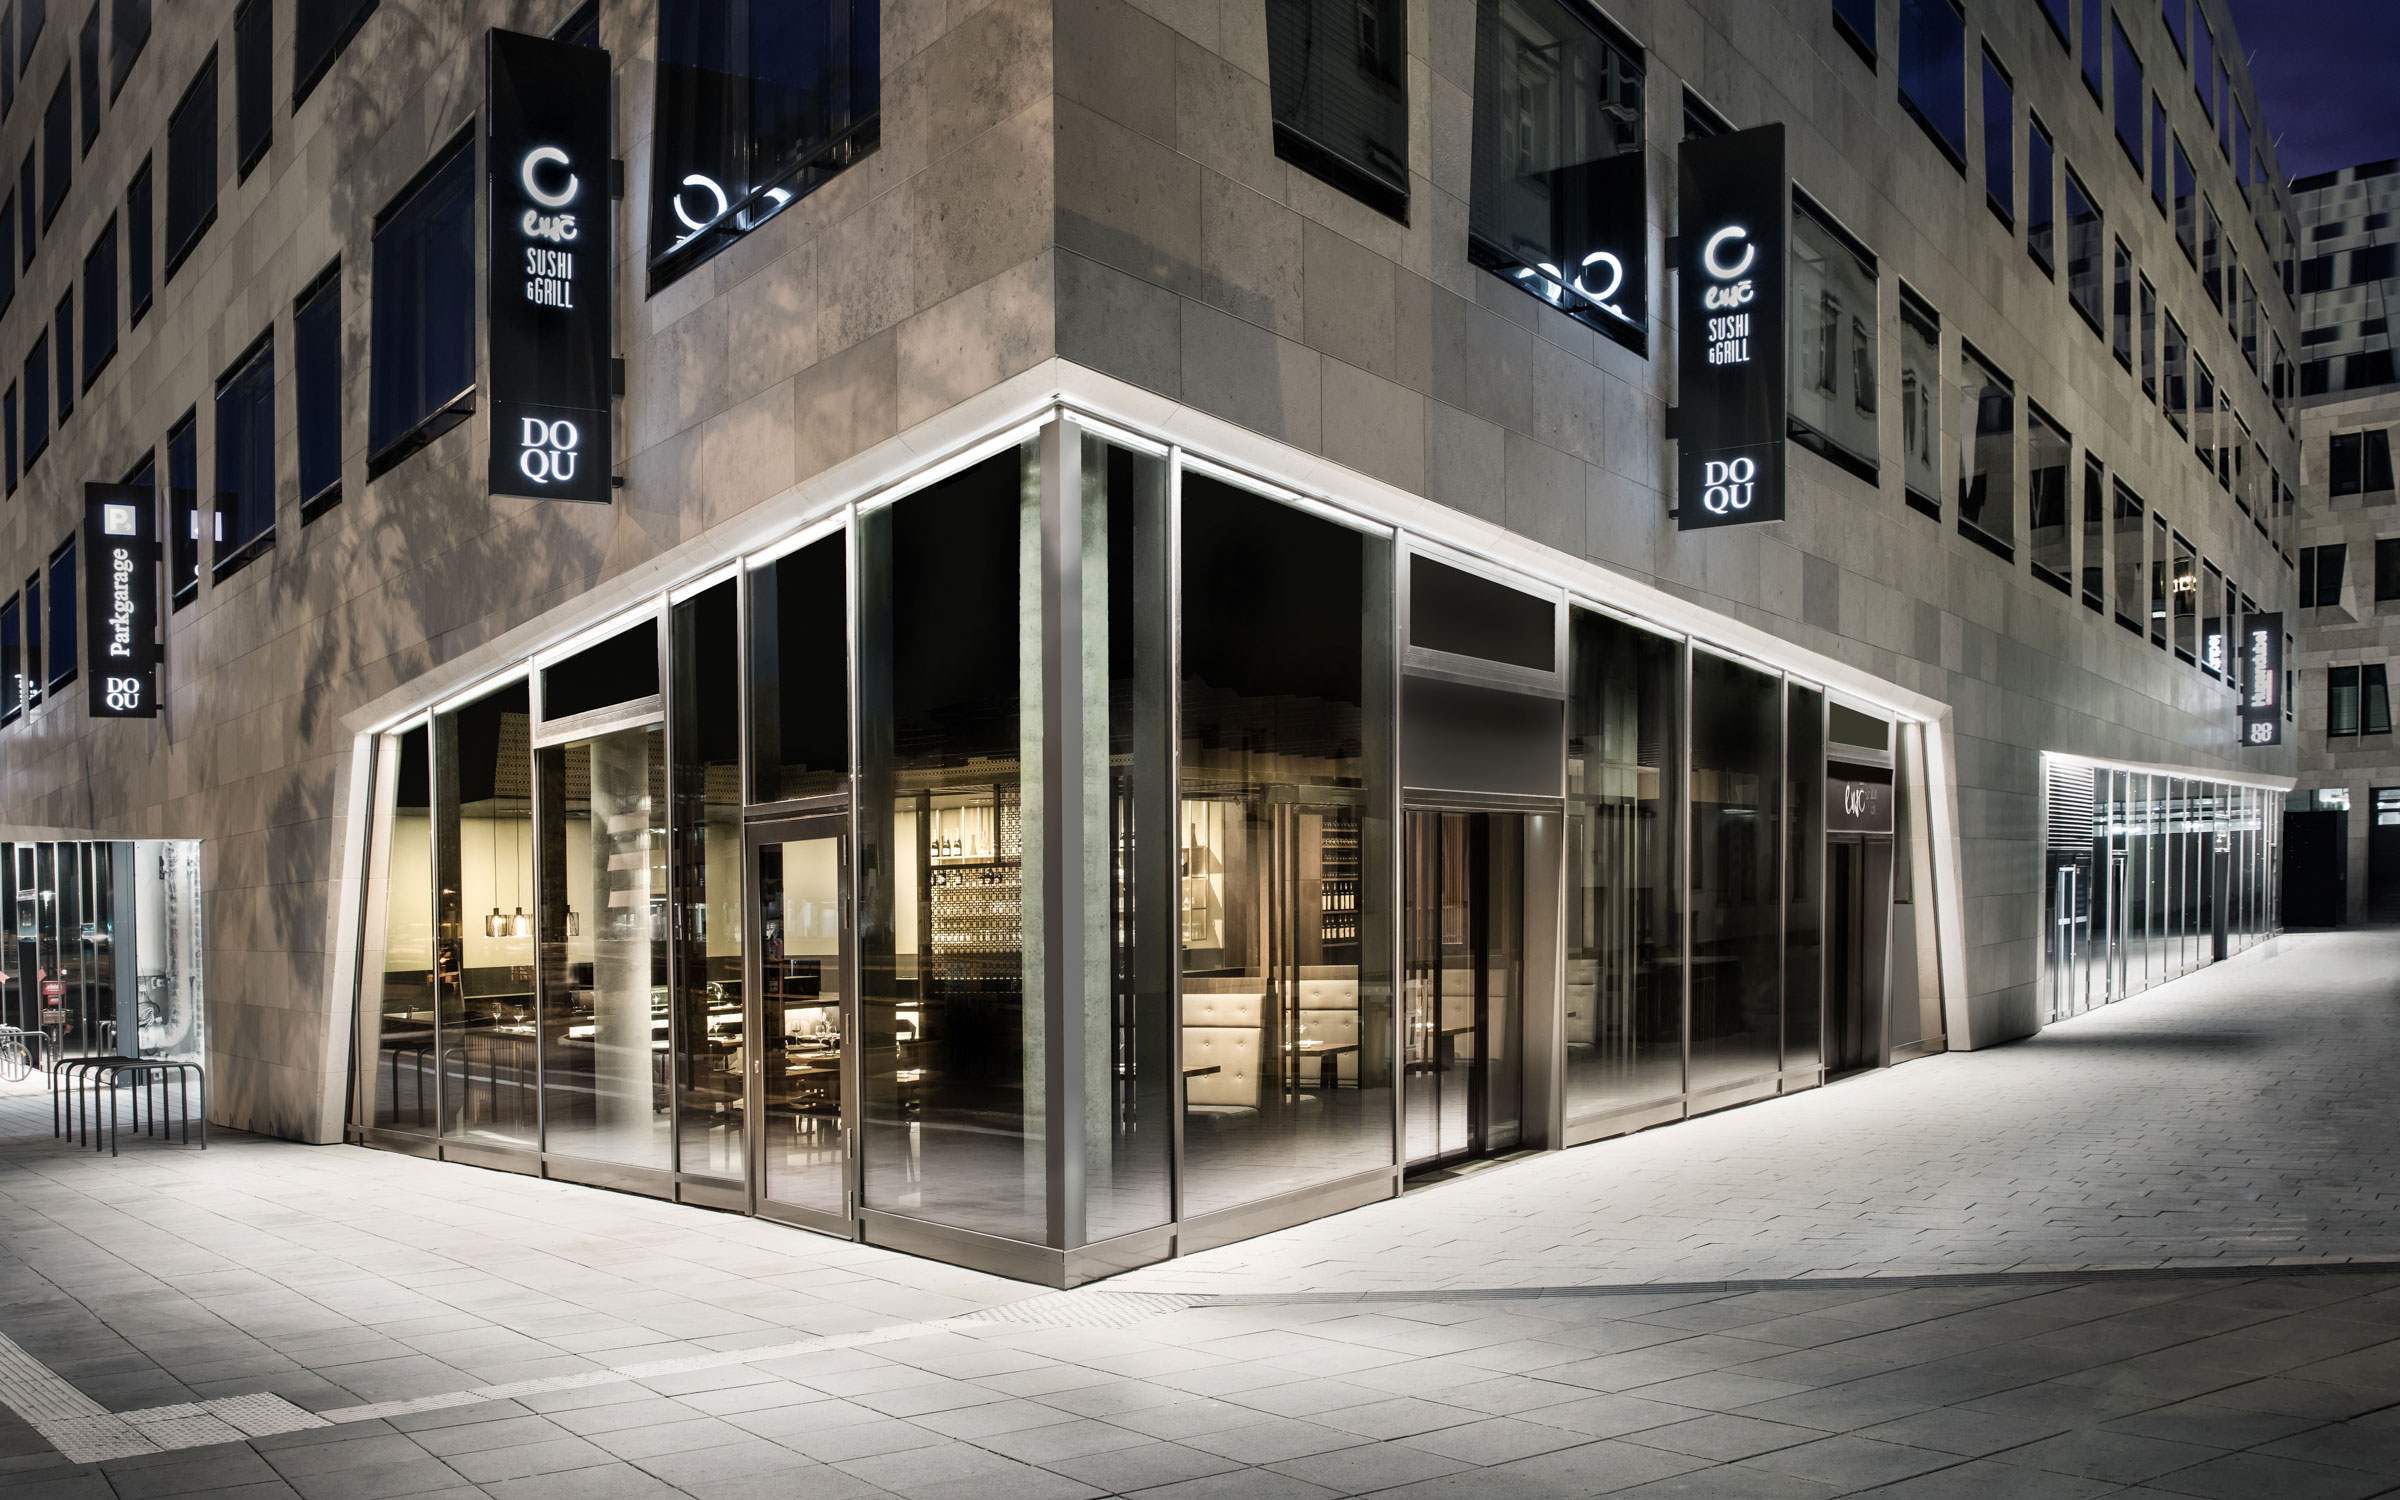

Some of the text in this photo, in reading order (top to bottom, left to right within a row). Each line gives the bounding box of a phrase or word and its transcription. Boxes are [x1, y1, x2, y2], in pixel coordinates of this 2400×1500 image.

[527, 247, 572, 280] SUSHI
[527, 277, 574, 308] &GRILL
[1708, 313, 1749, 342] SUSHI
[1708, 338, 1750, 365] &GRILL
[521, 417, 578, 450] DO
[519, 448, 578, 483] QU
[1704, 457, 1755, 486] DO
[1703, 482, 1754, 514] QU
[109, 508, 128, 530] P
[109, 548, 134, 657] Parkgarage
[106, 677, 140, 693] DO
[106, 692, 140, 711] QU
